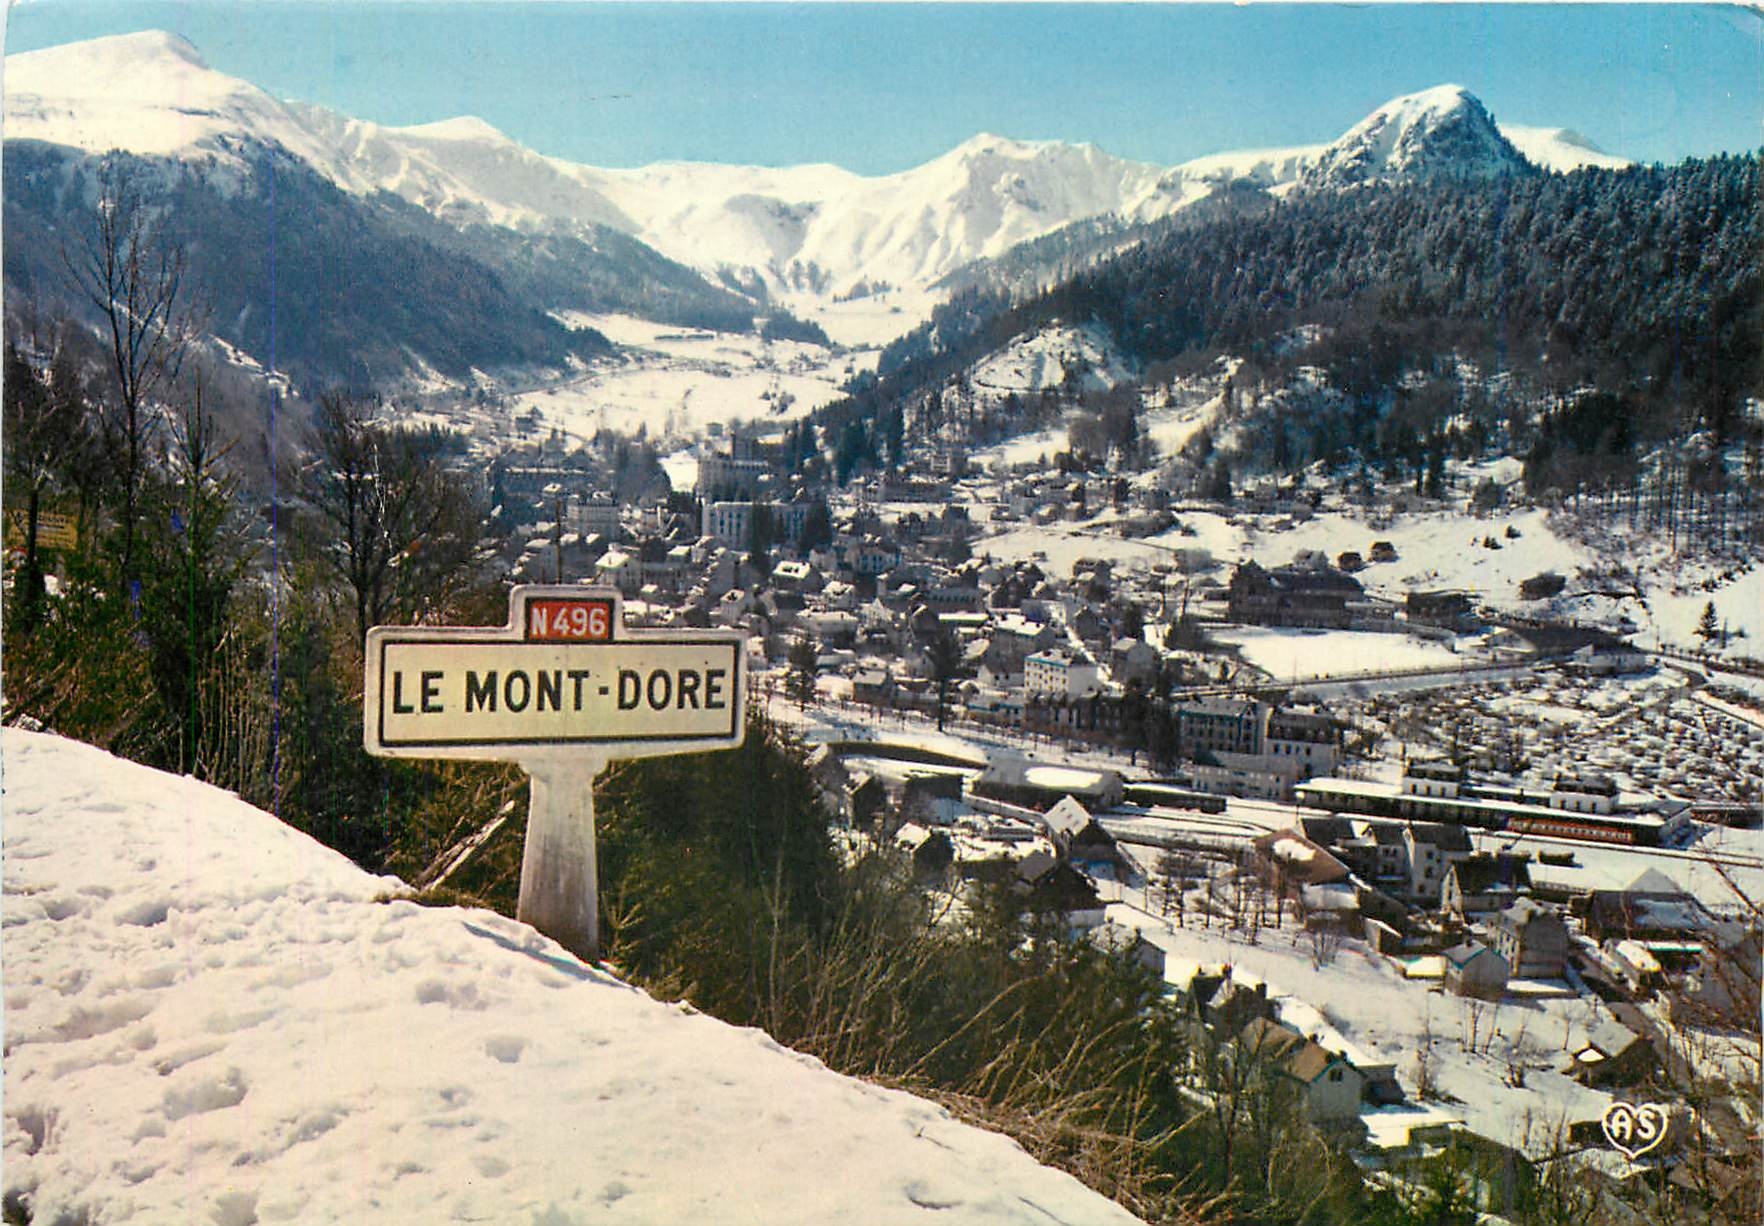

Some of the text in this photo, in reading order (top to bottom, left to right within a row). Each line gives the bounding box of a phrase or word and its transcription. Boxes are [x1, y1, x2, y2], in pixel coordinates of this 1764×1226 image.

[530, 606, 606, 636] N 496
[393, 669, 726, 714] LE MONT-DORE
